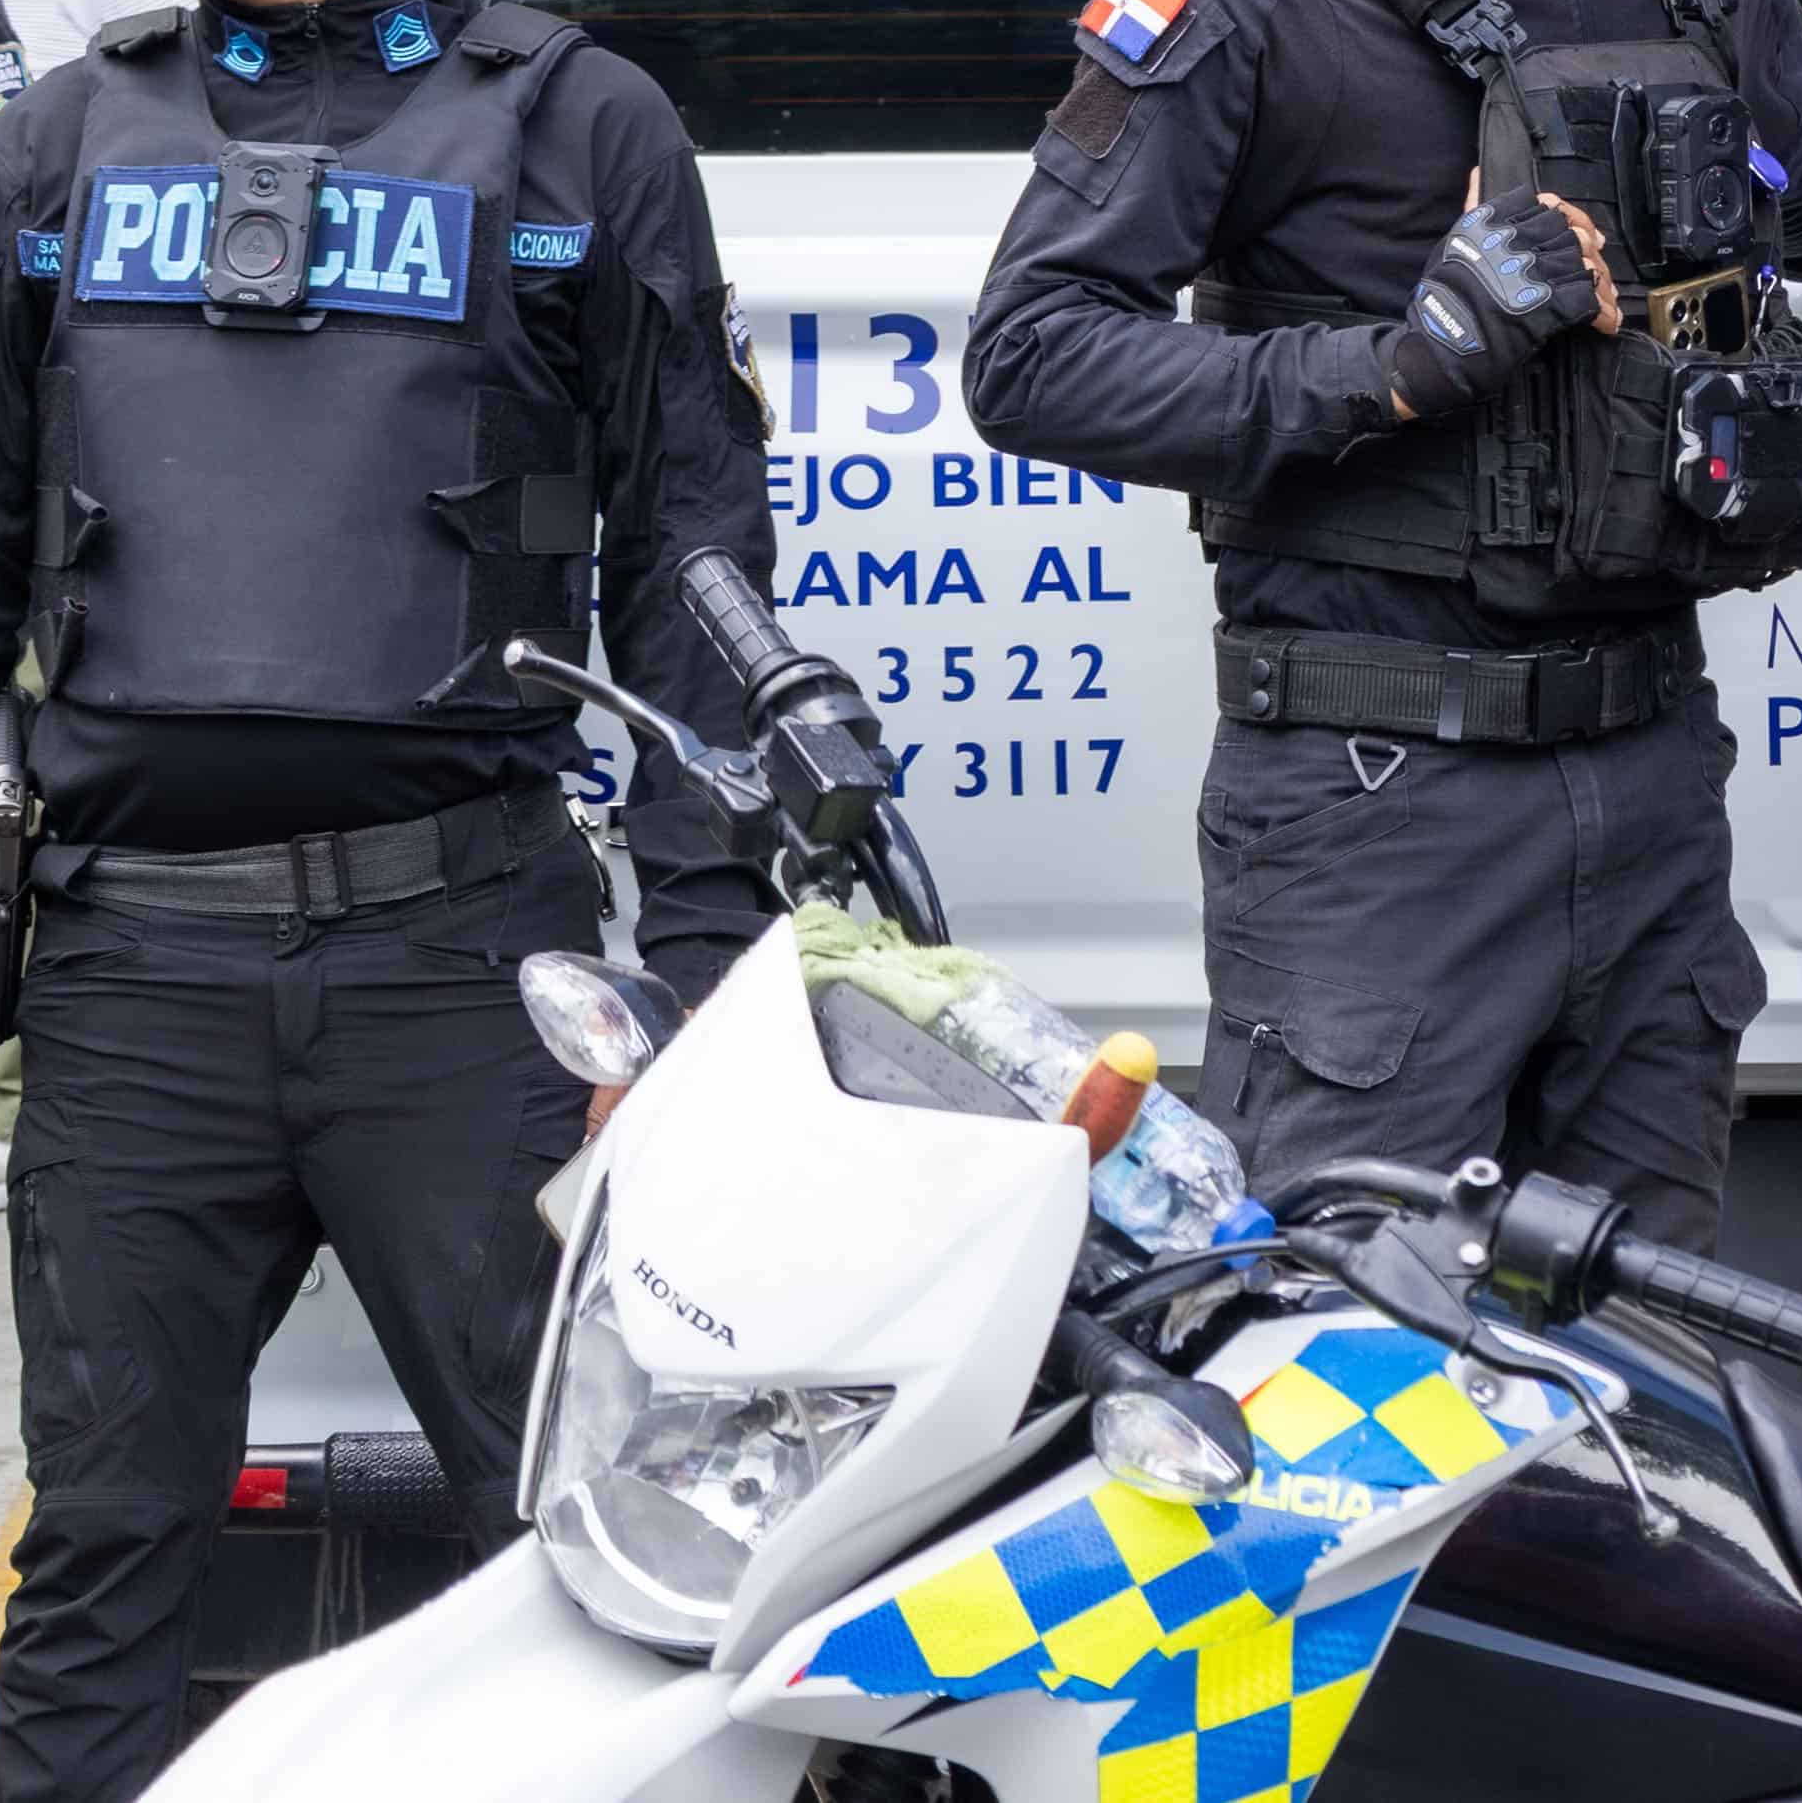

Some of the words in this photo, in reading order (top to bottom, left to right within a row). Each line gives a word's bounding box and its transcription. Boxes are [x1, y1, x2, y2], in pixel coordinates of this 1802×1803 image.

[1020, 545, 1131, 604] AL
[954, 738, 1126, 799] 3117
[632, 1258, 738, 1350] HONDA
